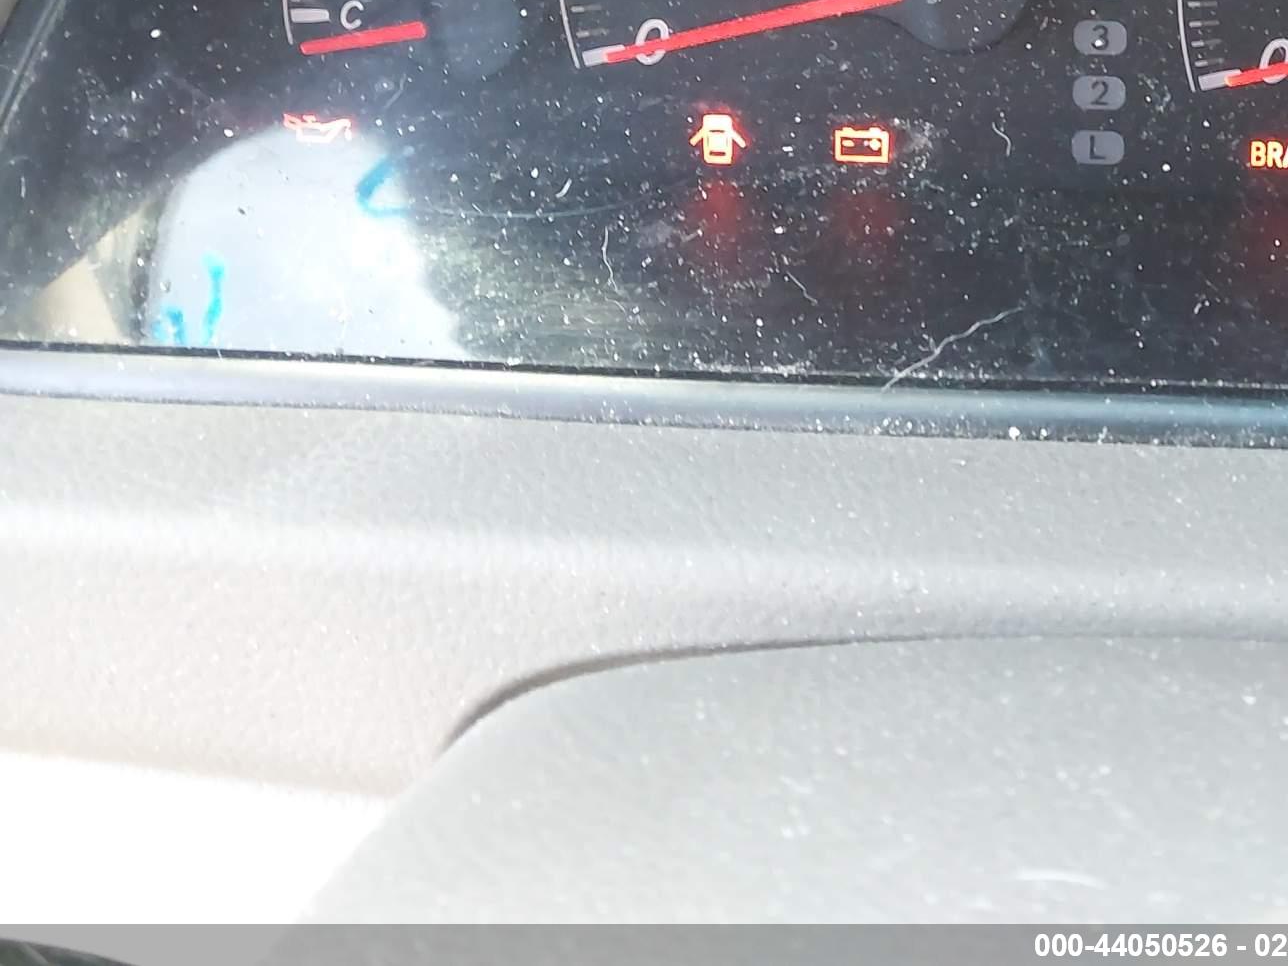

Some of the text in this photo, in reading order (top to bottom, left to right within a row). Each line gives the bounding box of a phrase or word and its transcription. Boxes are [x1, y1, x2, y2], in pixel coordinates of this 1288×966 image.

[340, 0, 364, 29] C
[1090, 27, 1109, 49] 3
[1090, 81, 1109, 105] 2
[1089, 137, 1107, 160] L
